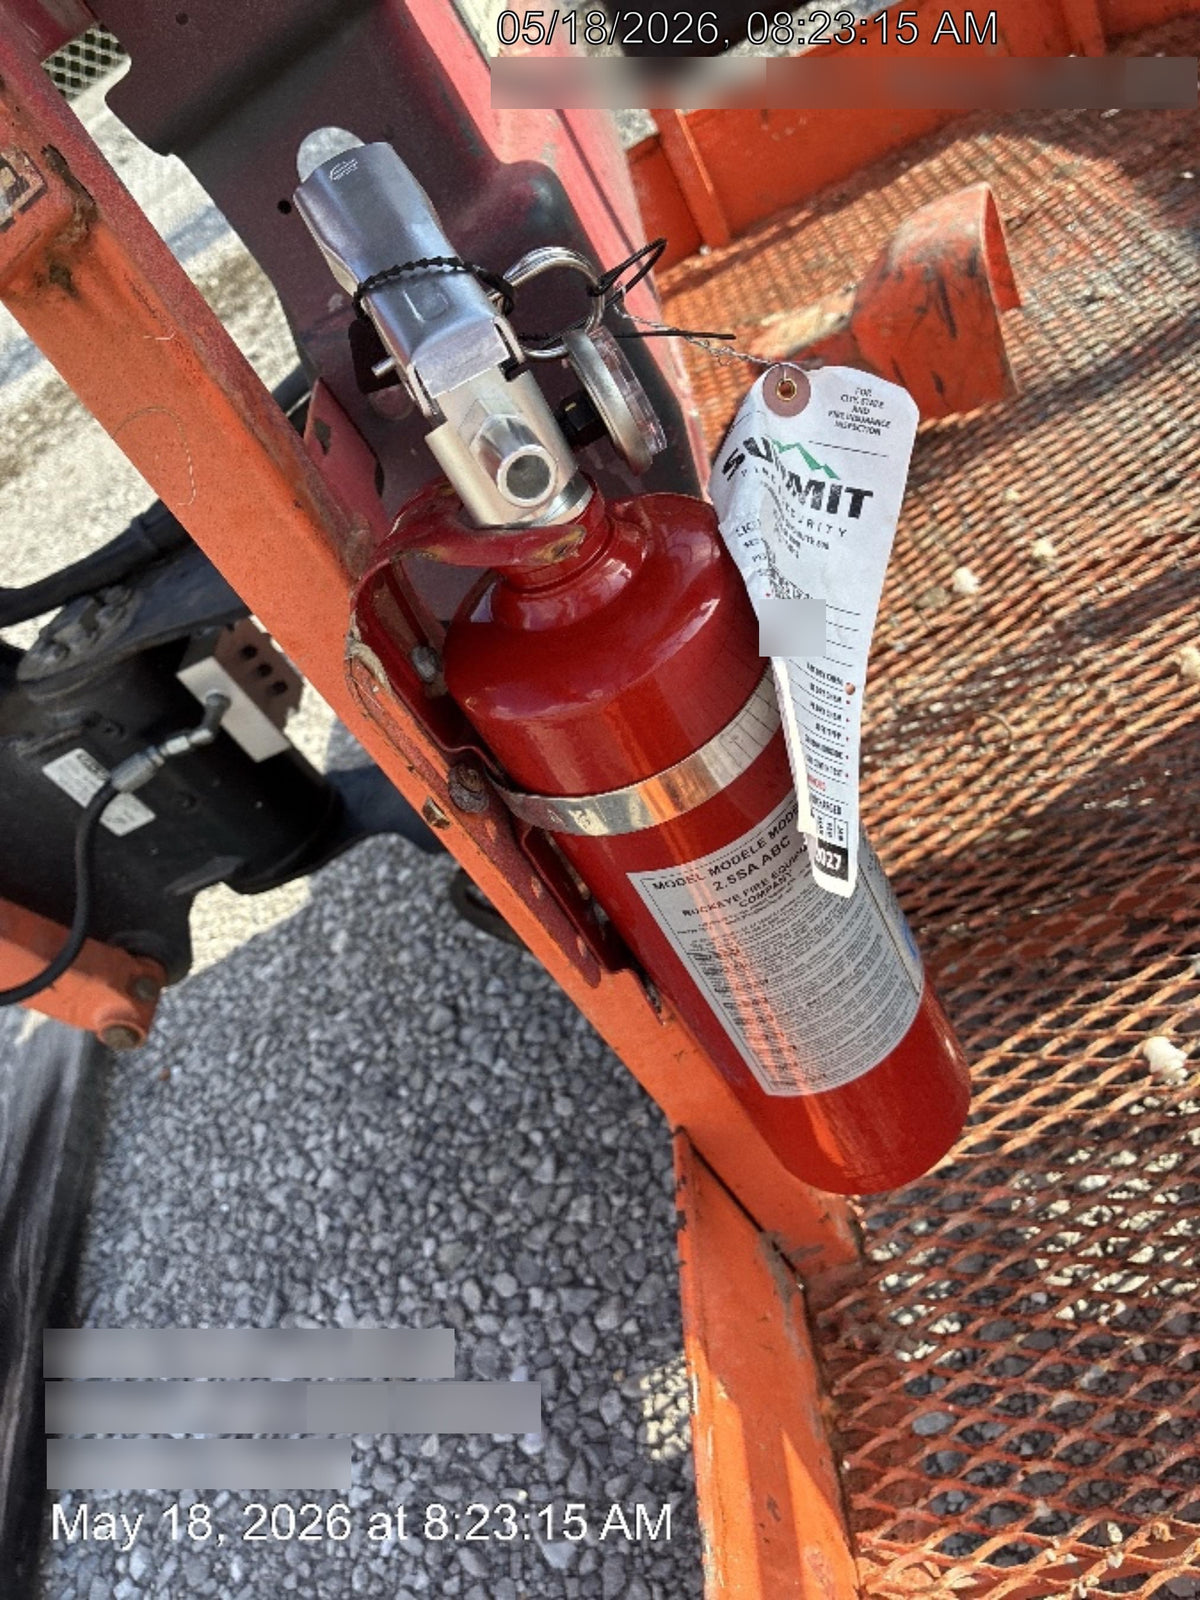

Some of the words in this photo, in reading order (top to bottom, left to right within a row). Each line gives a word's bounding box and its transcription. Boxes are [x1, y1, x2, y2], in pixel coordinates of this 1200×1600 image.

[652, 872, 707, 890] MODEL
[708, 837, 766, 876] MODELE
[762, 836, 791, 866] ABC
[739, 869, 793, 907] COMPANY
